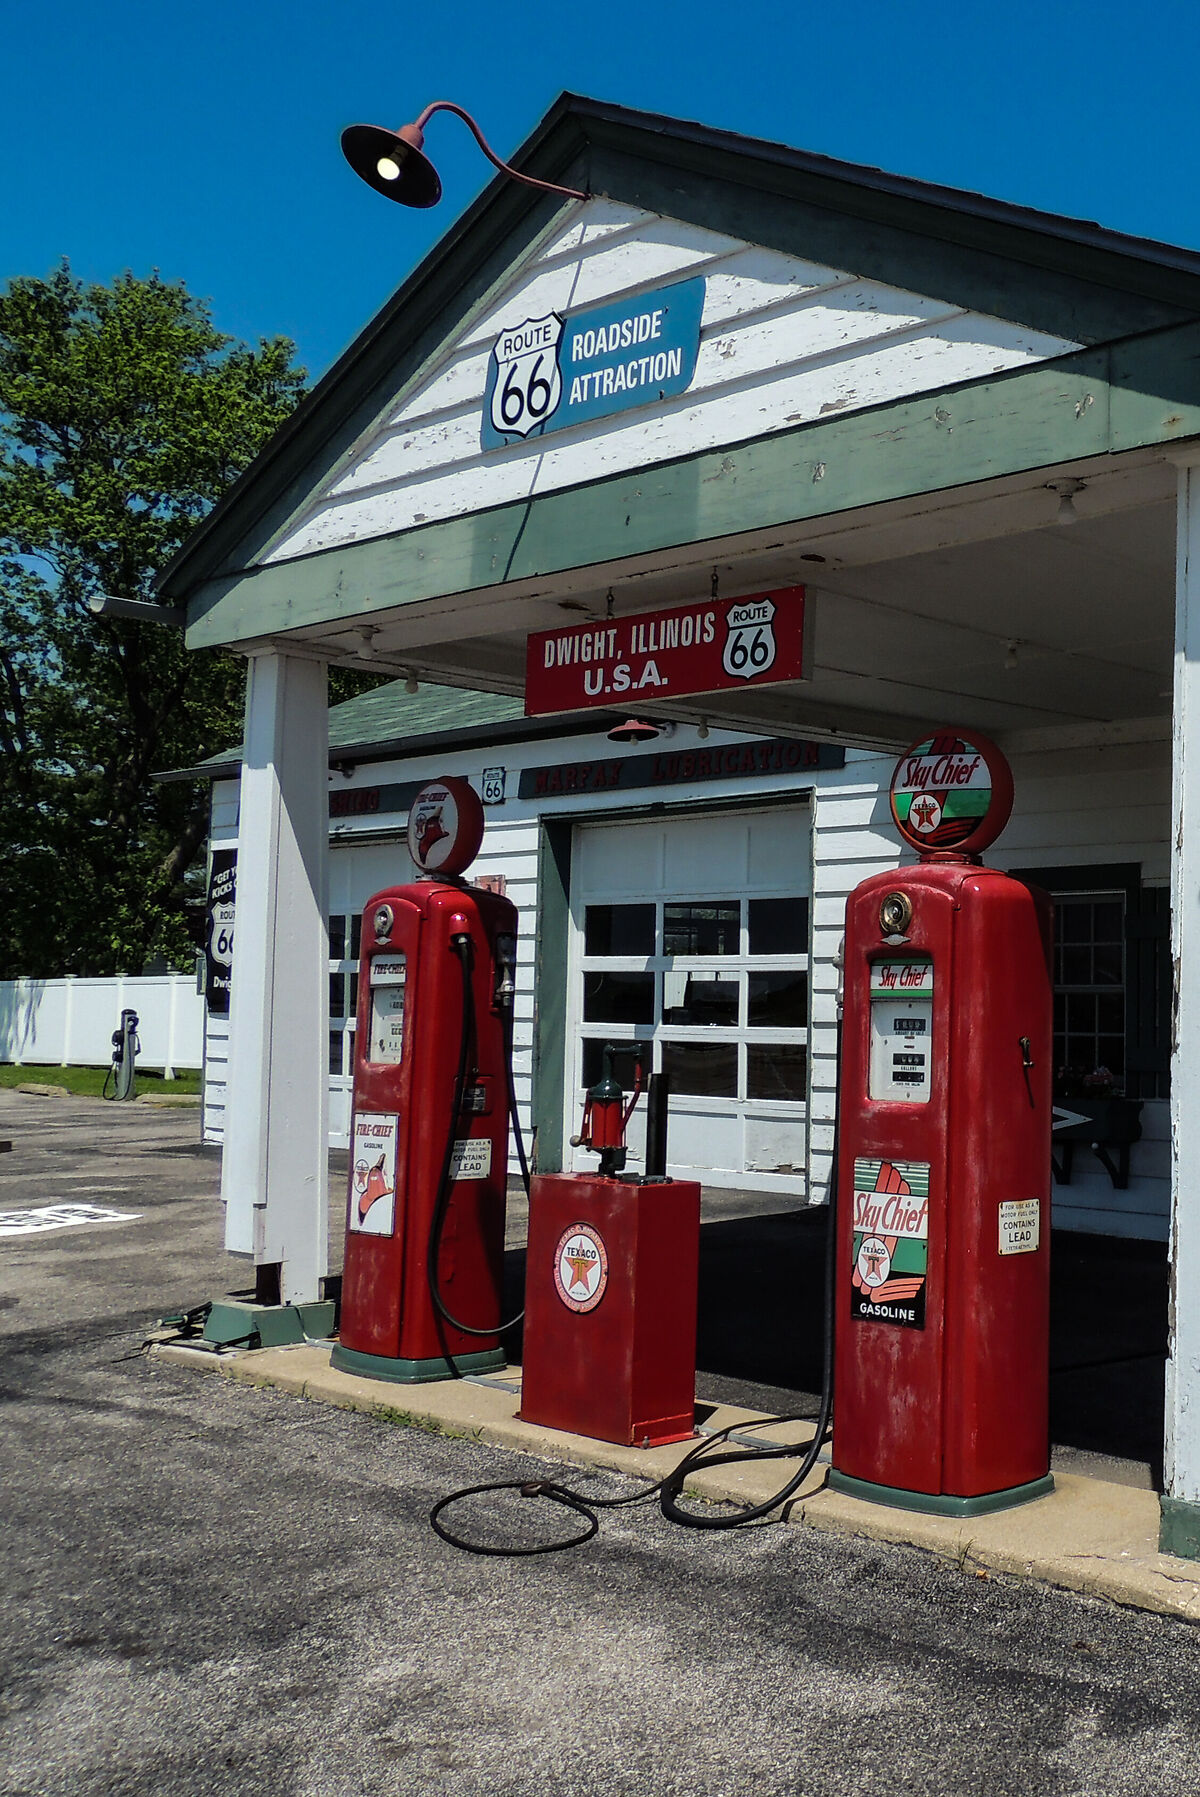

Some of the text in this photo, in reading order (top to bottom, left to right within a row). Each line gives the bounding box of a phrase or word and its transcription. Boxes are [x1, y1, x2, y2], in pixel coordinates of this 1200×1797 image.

[504, 323, 552, 355] ROUTE
[572, 309, 662, 362] ROADSIDE
[569, 348, 682, 405] ATTRACTION
[501, 353, 550, 426] 66
[733, 606, 768, 622] ROUTE
[544, 612, 716, 668] DWIGHT, ILLINOIS
[730, 628, 769, 670] 66
[584, 660, 668, 696] U.S.A.
[652, 740, 820, 781] LUBRICATION
[902, 756, 981, 790] Sky Chief
[486, 782, 500, 798] 66
[212, 880, 232, 900] KICKS
[878, 965, 928, 990] Sky Chief
[356, 1124, 394, 1138] FIRE-CHIEF
[364, 1142, 384, 1150] GASOLINE
[454, 1154, 487, 1162] CONTAINS
[458, 1162, 482, 1172] LEAD
[854, 1193, 928, 1234] Sky Chief
[1003, 1219, 1036, 1230] CONTAINS
[1008, 1231, 1031, 1242] LEAD
[567, 1247, 596, 1260] TEXACO
[863, 1246, 886, 1256] TEXACO
[860, 1303, 916, 1322] GASOLINE
